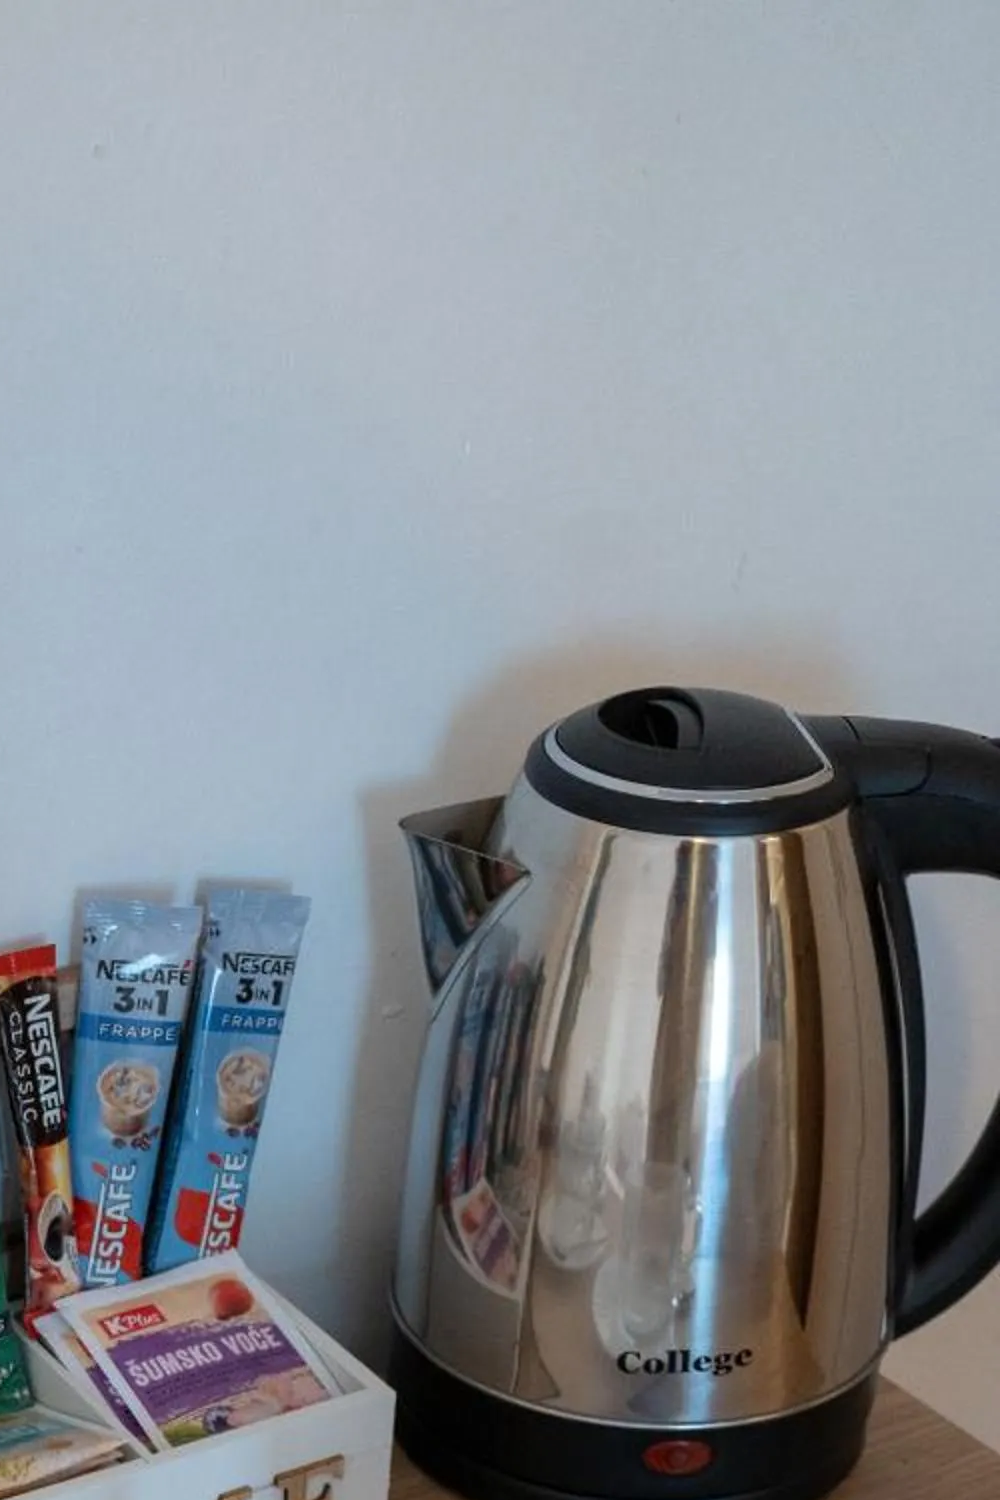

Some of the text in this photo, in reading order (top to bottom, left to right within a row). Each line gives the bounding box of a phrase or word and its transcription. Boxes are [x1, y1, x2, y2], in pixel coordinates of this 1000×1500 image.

[222, 951, 297, 977] NESCAF
[8, 1010, 39, 1124] CLASSIC
[124, 1341, 224, 1387] ŠUMSKO
[617, 1349, 753, 1376] College
